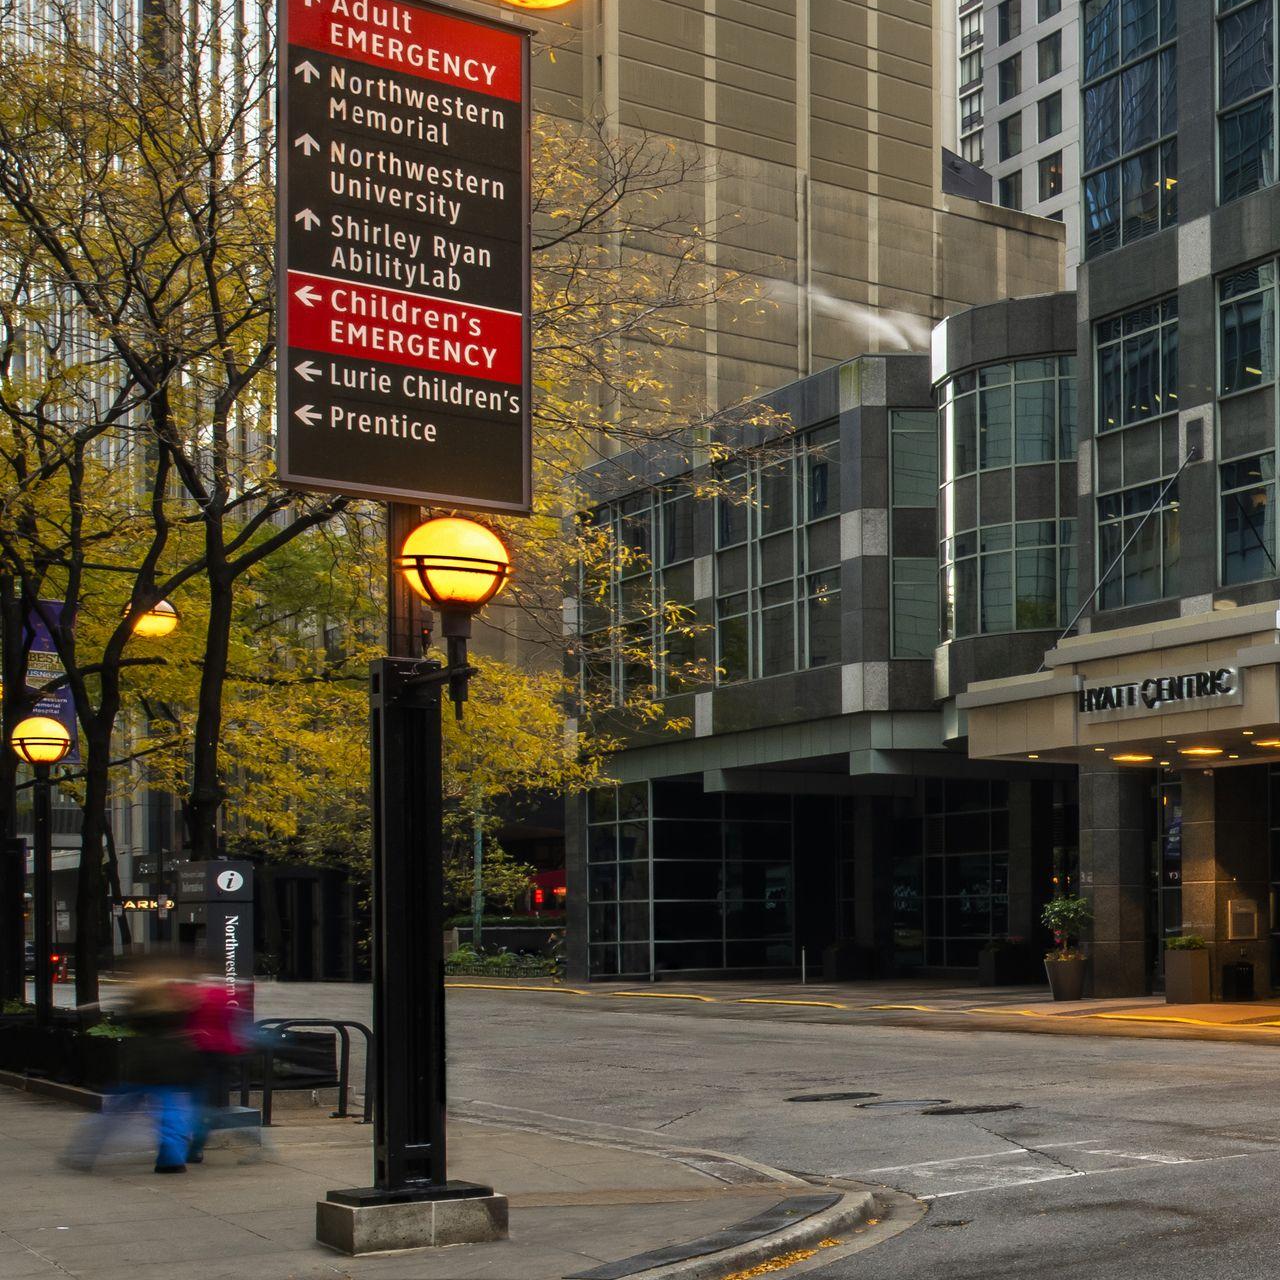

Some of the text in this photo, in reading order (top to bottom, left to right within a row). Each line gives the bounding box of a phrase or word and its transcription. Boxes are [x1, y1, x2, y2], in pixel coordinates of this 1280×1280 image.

[330, 23, 497, 85] EMERGENCY
[329, 97, 449, 146] Memorial
[330, 66, 505, 129] Northwestern
[330, 140, 505, 200] Northwestern
[331, 171, 461, 224] University
[331, 215, 491, 268] Shirley Ryan
[331, 246, 461, 291] AbilityLab
[331, 289, 482, 337] Children's
[331, 320, 497, 369] EMERGENCY
[331, 363, 520, 414] Lurie Children's
[330, 406, 437, 442] Prentice
[1079, 668, 1235, 713] HYATT CENTRIC
[225, 915, 239, 996] Northwestern
